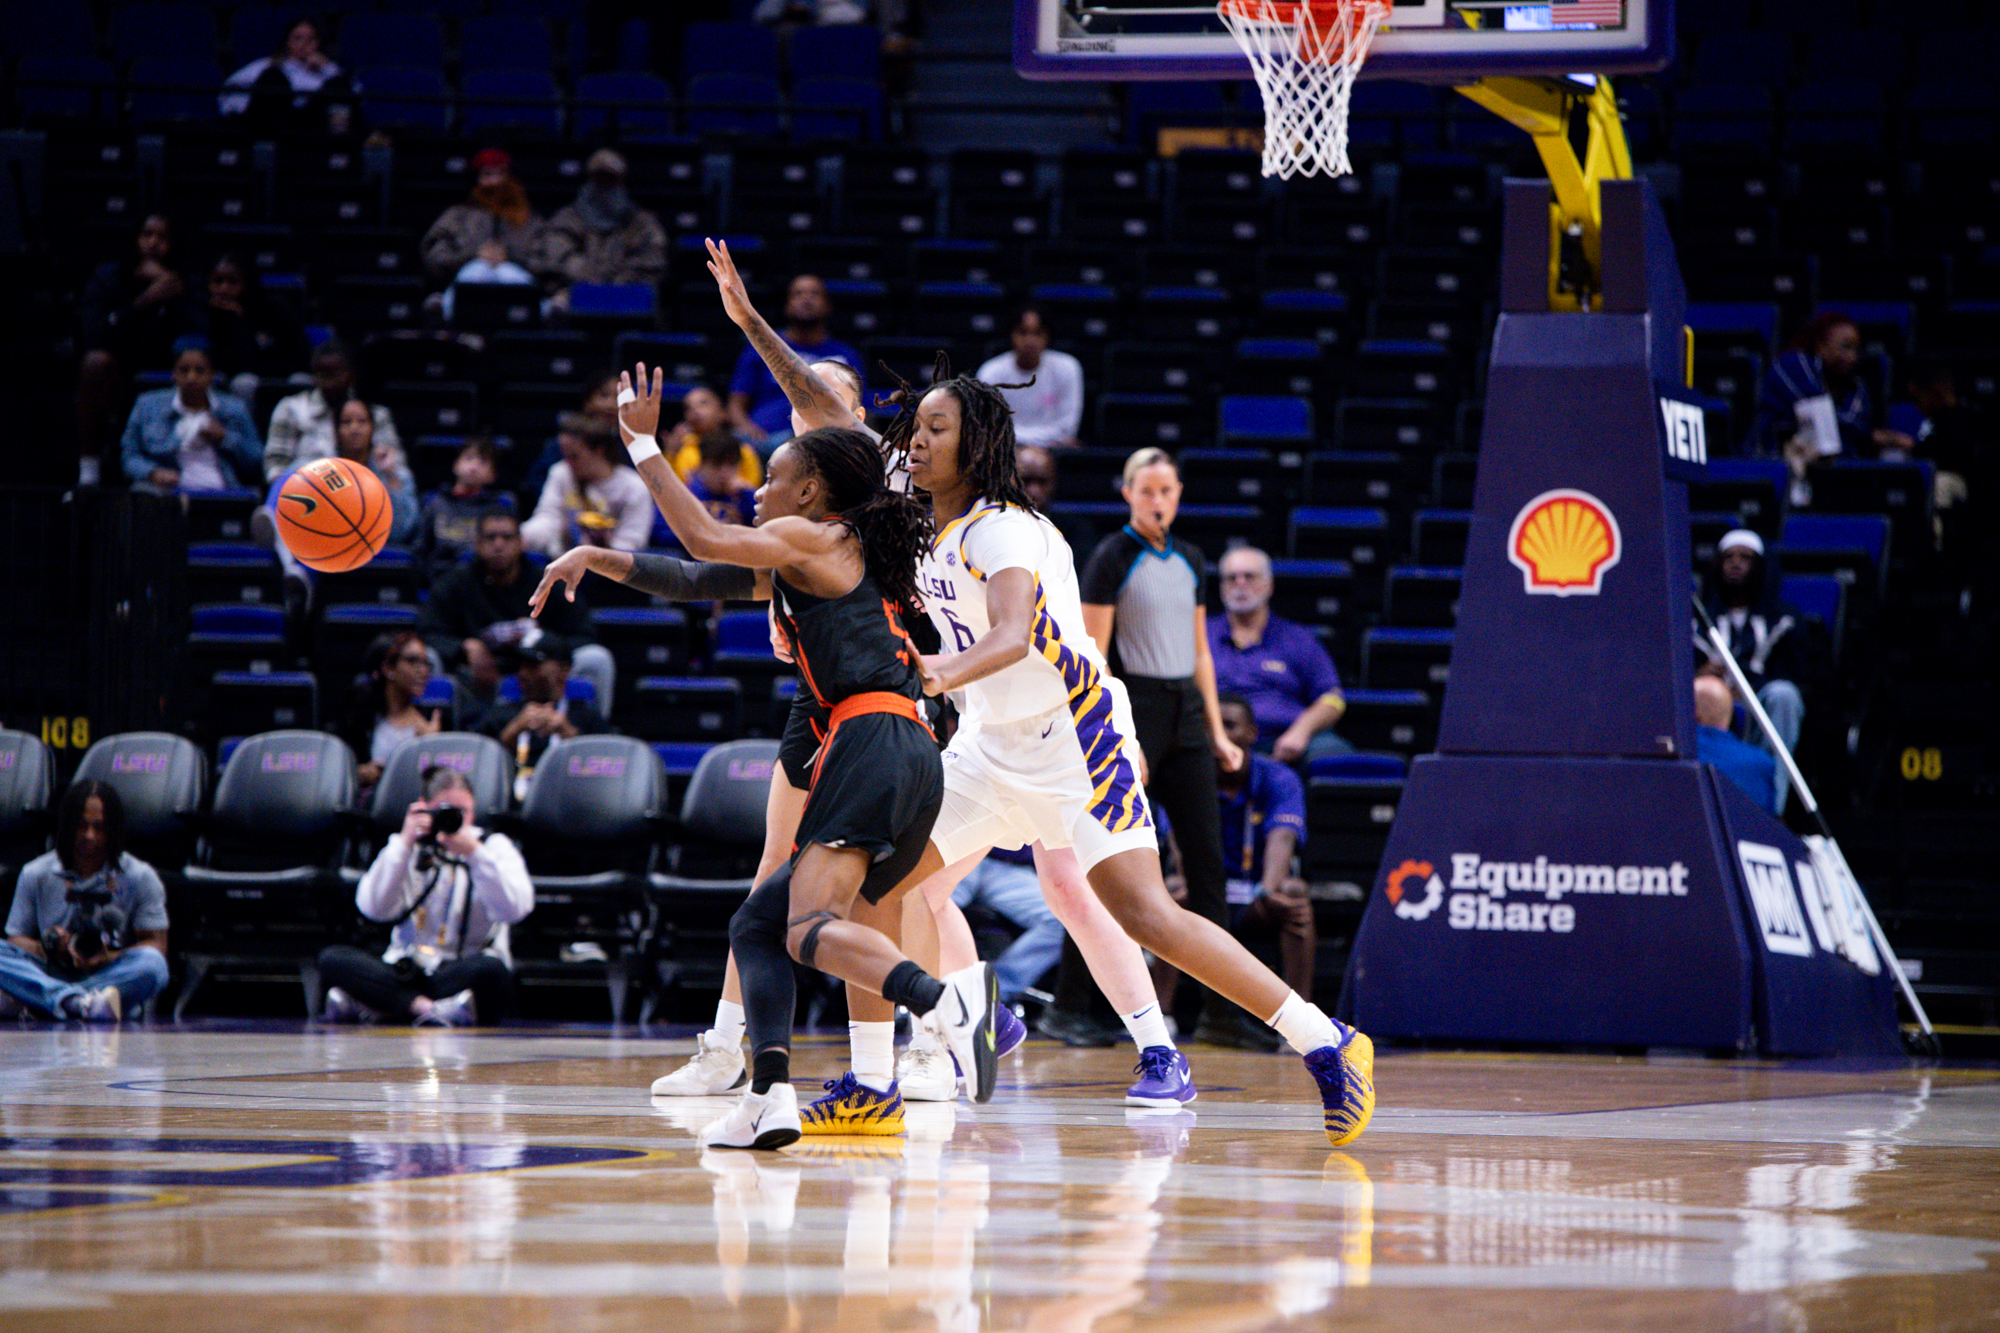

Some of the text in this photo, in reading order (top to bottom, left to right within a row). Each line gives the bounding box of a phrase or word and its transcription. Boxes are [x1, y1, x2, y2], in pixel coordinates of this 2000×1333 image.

[1660, 397, 1707, 465] YETI
[922, 572, 956, 601] LSU
[940, 606, 976, 653] 6
[42, 716, 90, 749] 108
[112, 753, 167, 774] LSU
[261, 752, 318, 773] LSU
[568, 755, 626, 778] LSU
[1450, 853, 1689, 900] Equipment
[1449, 893, 1576, 933] Share
